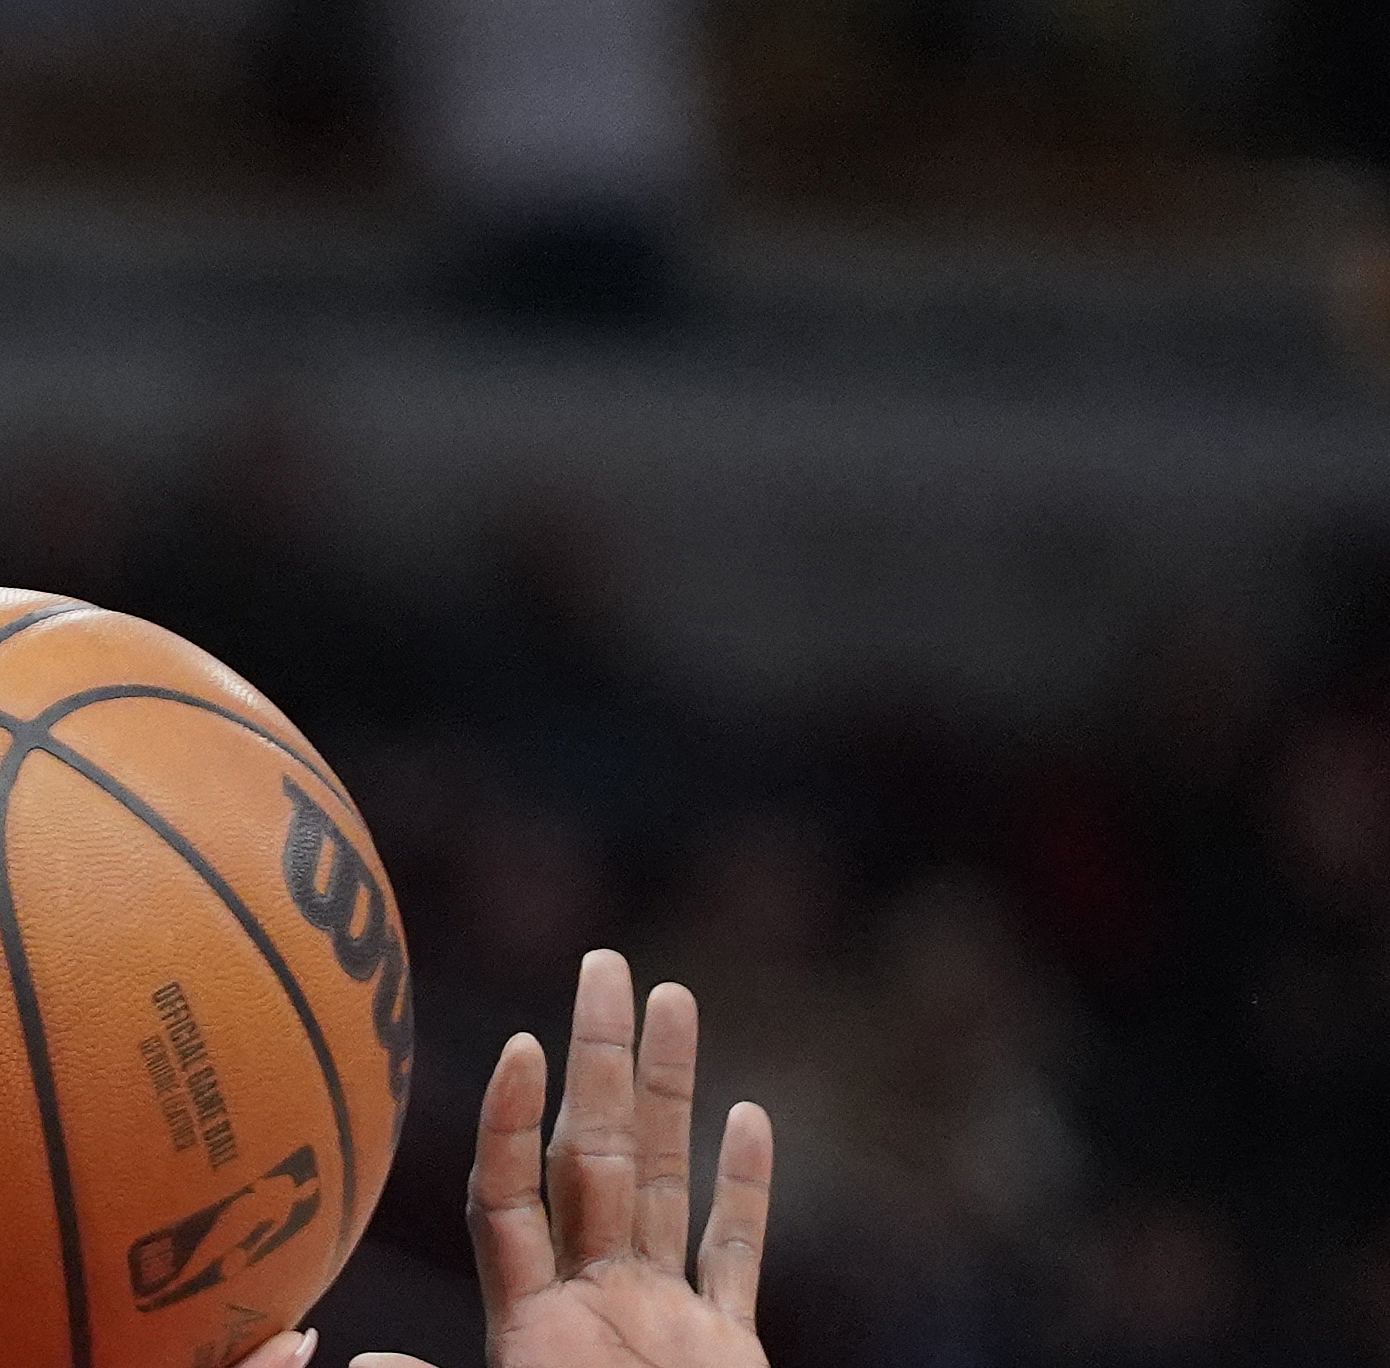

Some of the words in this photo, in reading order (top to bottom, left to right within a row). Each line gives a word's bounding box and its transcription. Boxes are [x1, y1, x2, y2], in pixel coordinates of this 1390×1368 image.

[152, 980, 208, 1072] OFFICIAL
[185, 1065, 229, 1125] GAME
[202, 1118, 240, 1171] BALL
